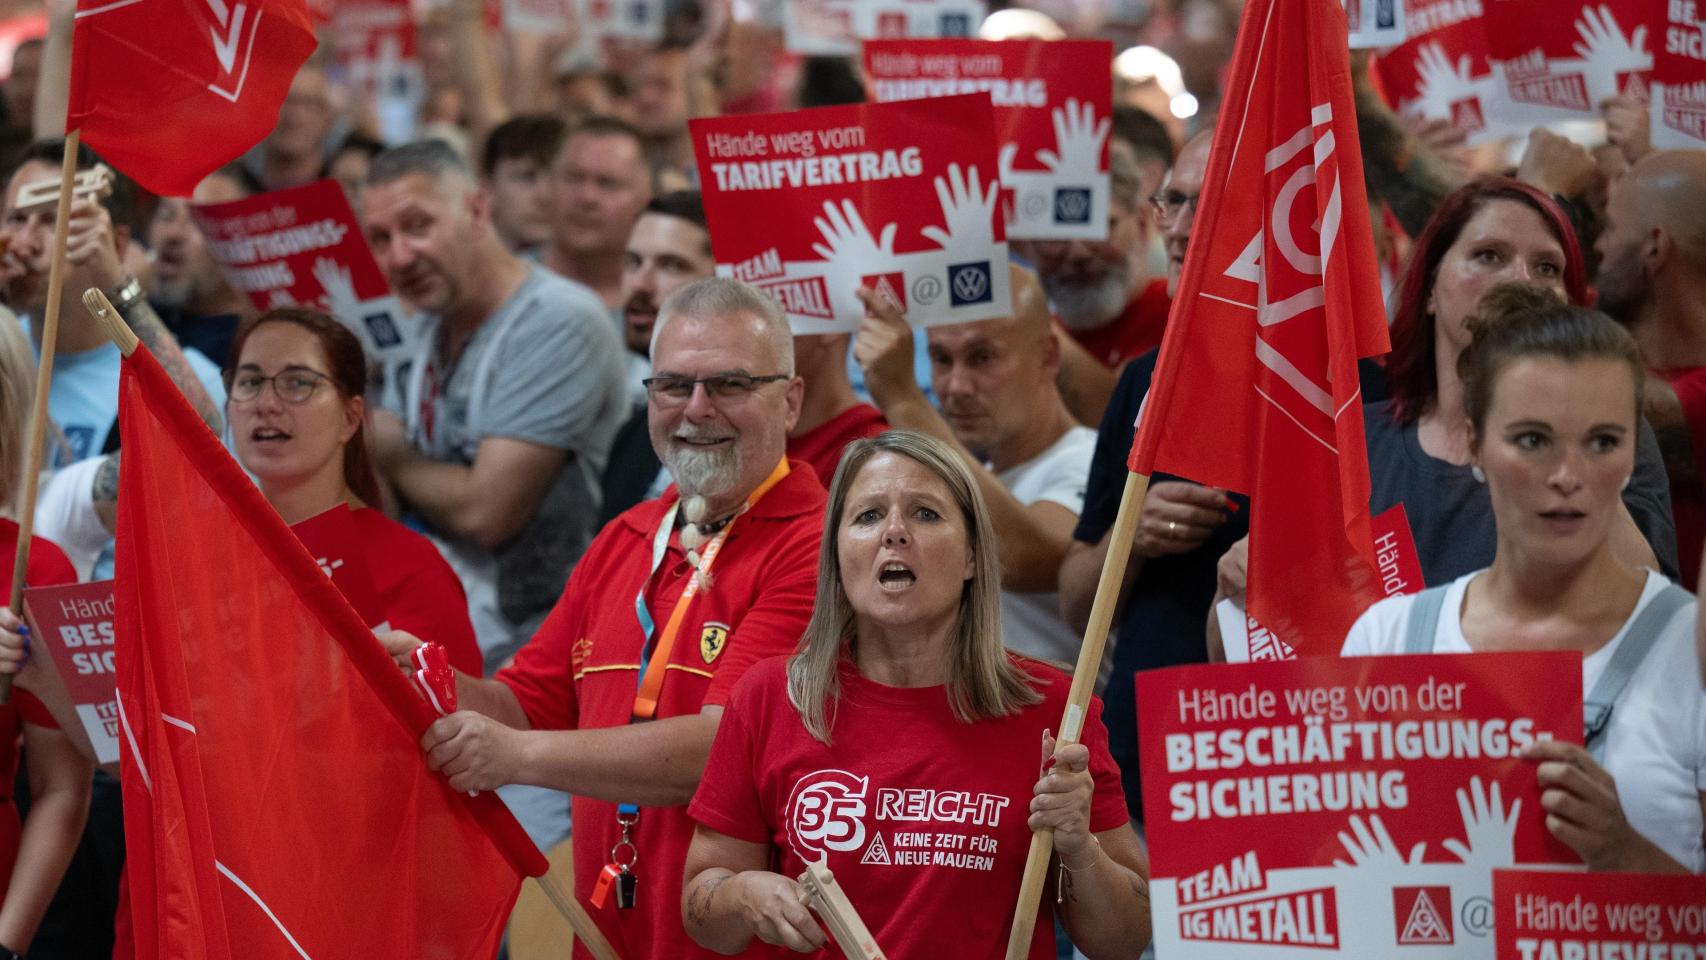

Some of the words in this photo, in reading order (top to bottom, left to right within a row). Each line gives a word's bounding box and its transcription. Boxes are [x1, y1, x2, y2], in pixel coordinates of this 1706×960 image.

[1668, 0, 1698, 26] BE
[707, 130, 768, 158] Hände
[770, 132, 816, 157] weg
[818, 127, 866, 150] vom
[712, 147, 923, 191] TARIFVERTRAG
[735, 247, 782, 283] TEAM
[58, 621, 115, 648] BES
[1178, 682, 1276, 724] Hände
[1285, 684, 1347, 721] weg
[1354, 683, 1408, 713] von
[1417, 675, 1466, 712] der
[1165, 715, 1554, 773] BESCHÄFTIGUNGS-
[1169, 769, 1409, 822] SICHERUNG
[796, 788, 867, 852] 35
[874, 787, 1010, 828] REICHT
[893, 832, 932, 848] KEINE
[934, 833, 965, 849] ZEIT
[969, 833, 998, 853] FÜR
[894, 851, 931, 866] NEUE
[933, 851, 994, 871] MAUERN
[1179, 850, 1262, 903] TEAM
[1183, 910, 1209, 938] IG
[1212, 892, 1334, 944] METALL
[1515, 893, 1598, 932] Hände
[1605, 903, 1660, 941] weg
[1667, 904, 1706, 934] vo
